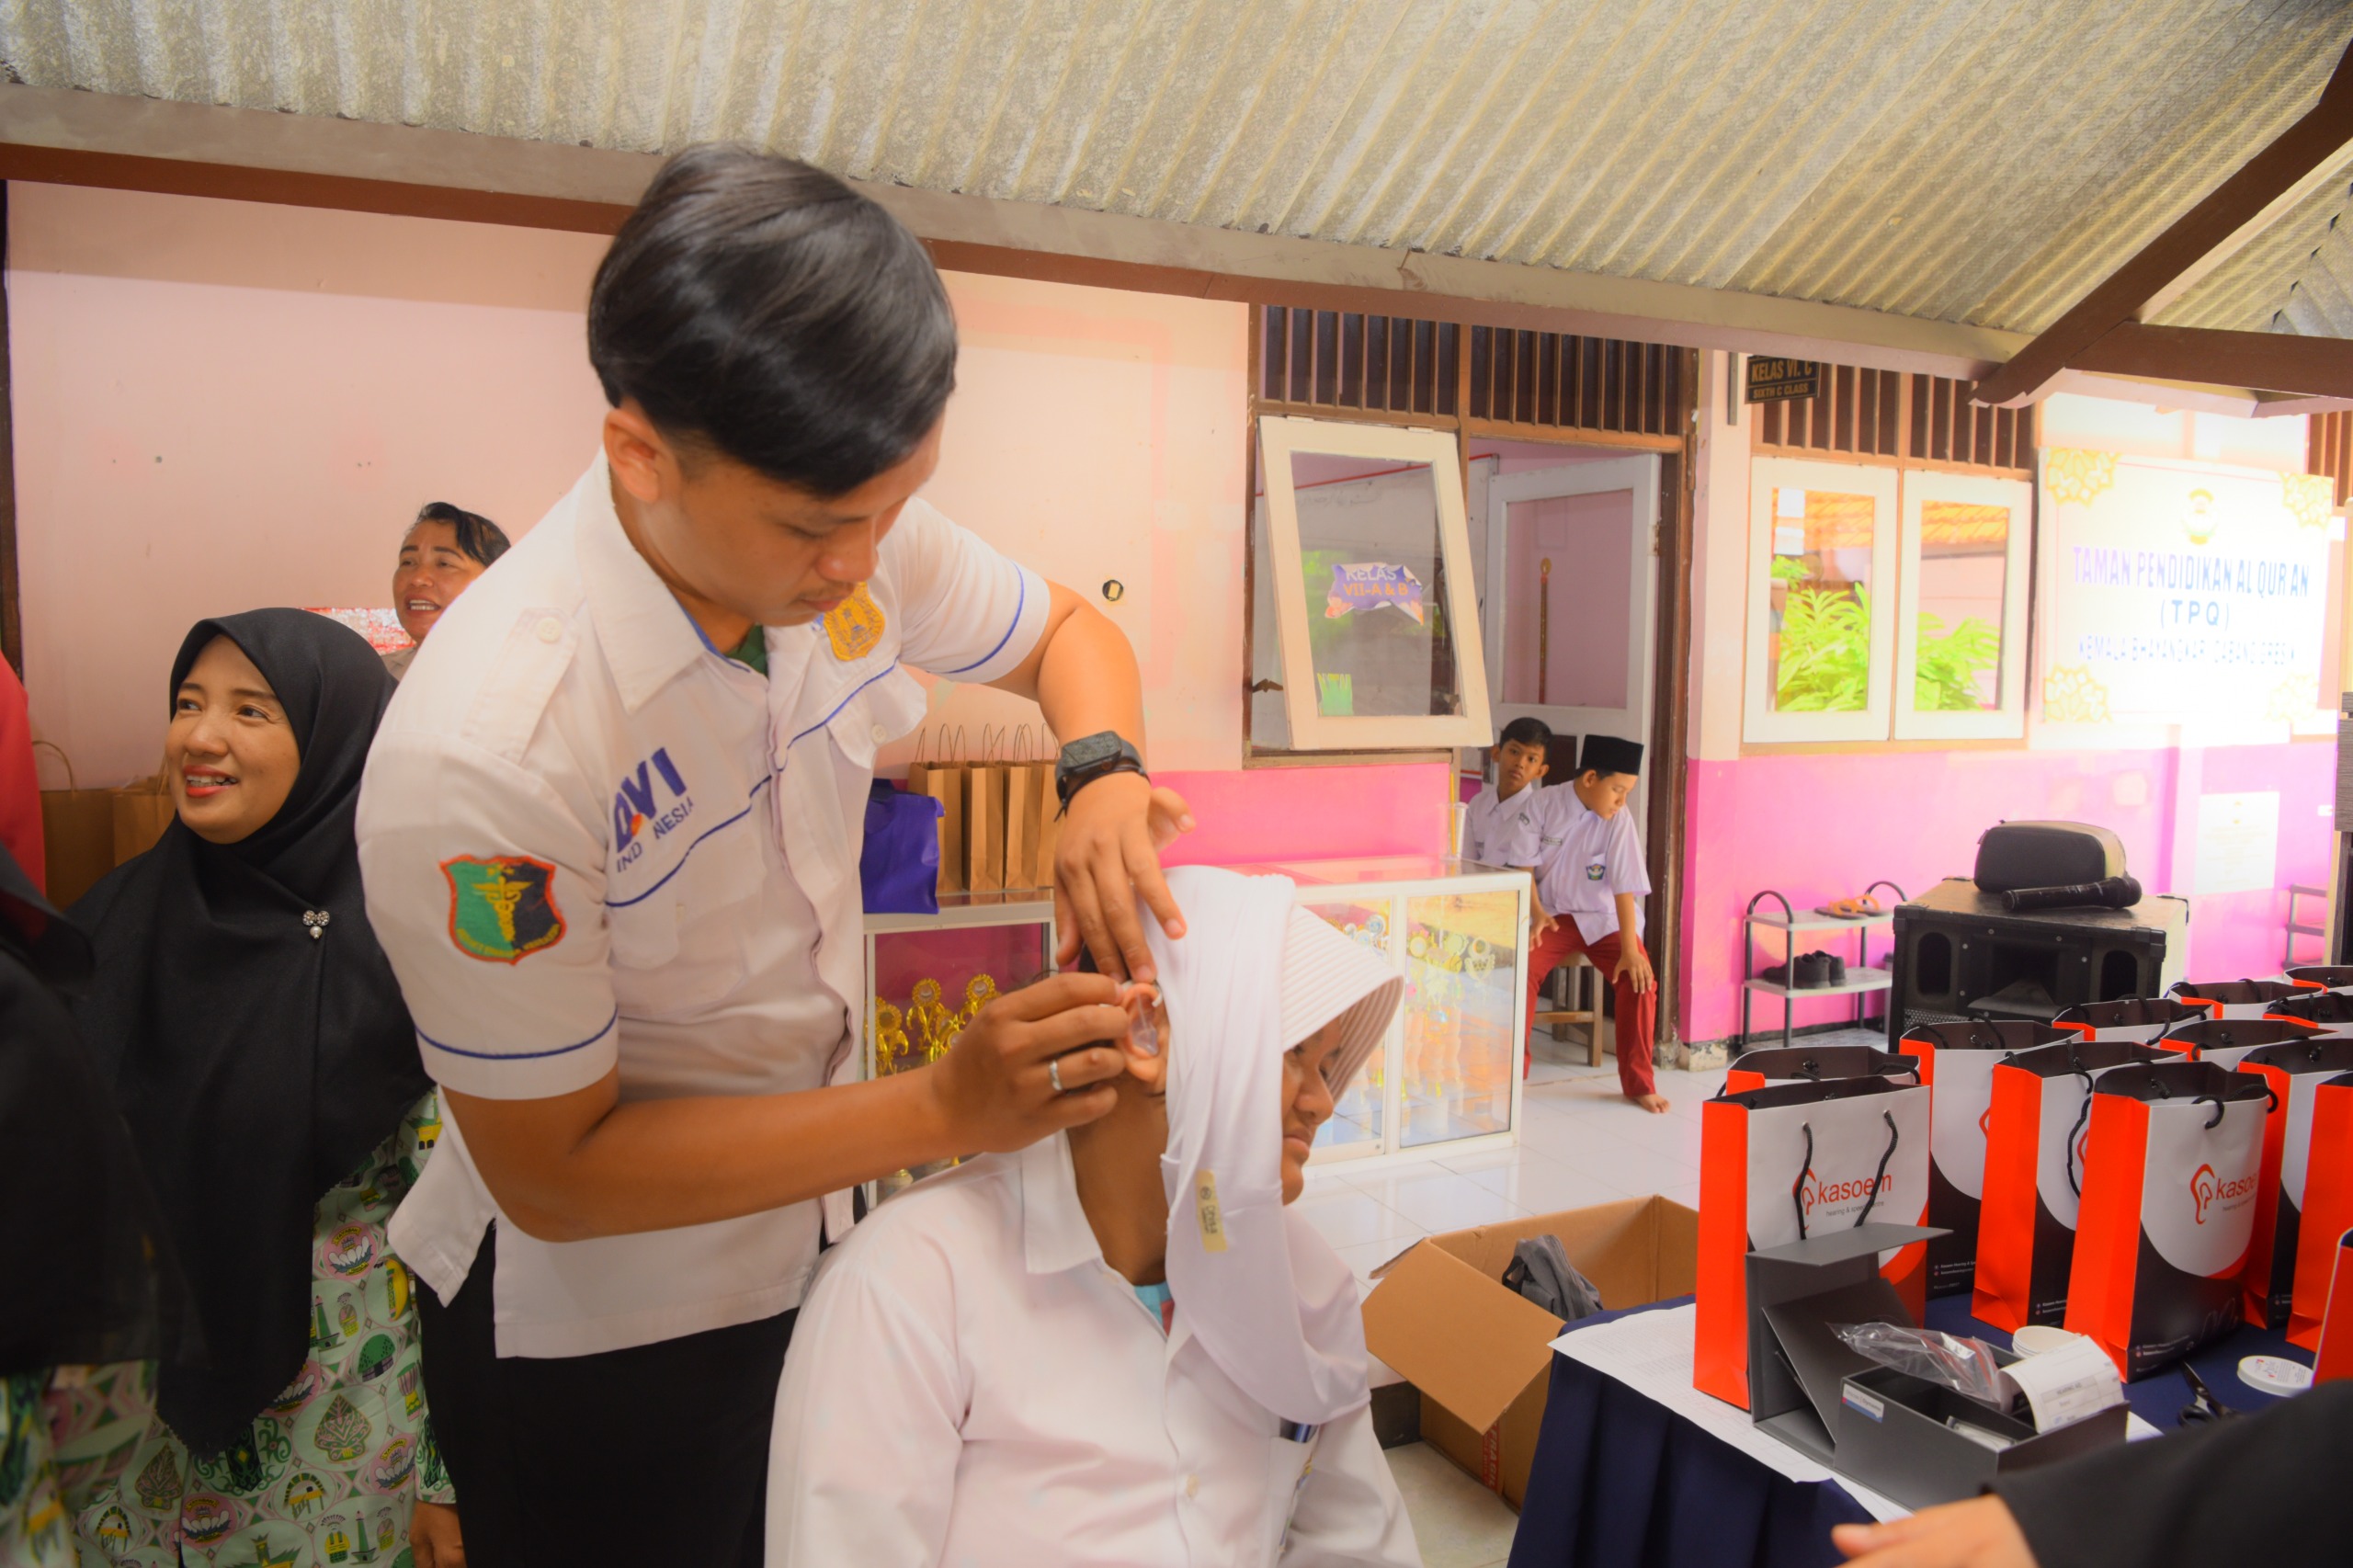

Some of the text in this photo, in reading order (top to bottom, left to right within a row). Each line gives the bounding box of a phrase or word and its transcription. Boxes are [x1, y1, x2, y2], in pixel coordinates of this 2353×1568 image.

[1751, 359, 1784, 382] KELAS
[1753, 383, 1809, 399] SIXTH C CLASS
[1346, 567, 1397, 581] KELAS
[2073, 546, 2131, 585] TAMAN
[2137, 551, 2233, 592] PENDIDIKAN
[2236, 559, 2252, 594] AL
[1384, 582, 1395, 596] &
[1398, 582, 1409, 596] B
